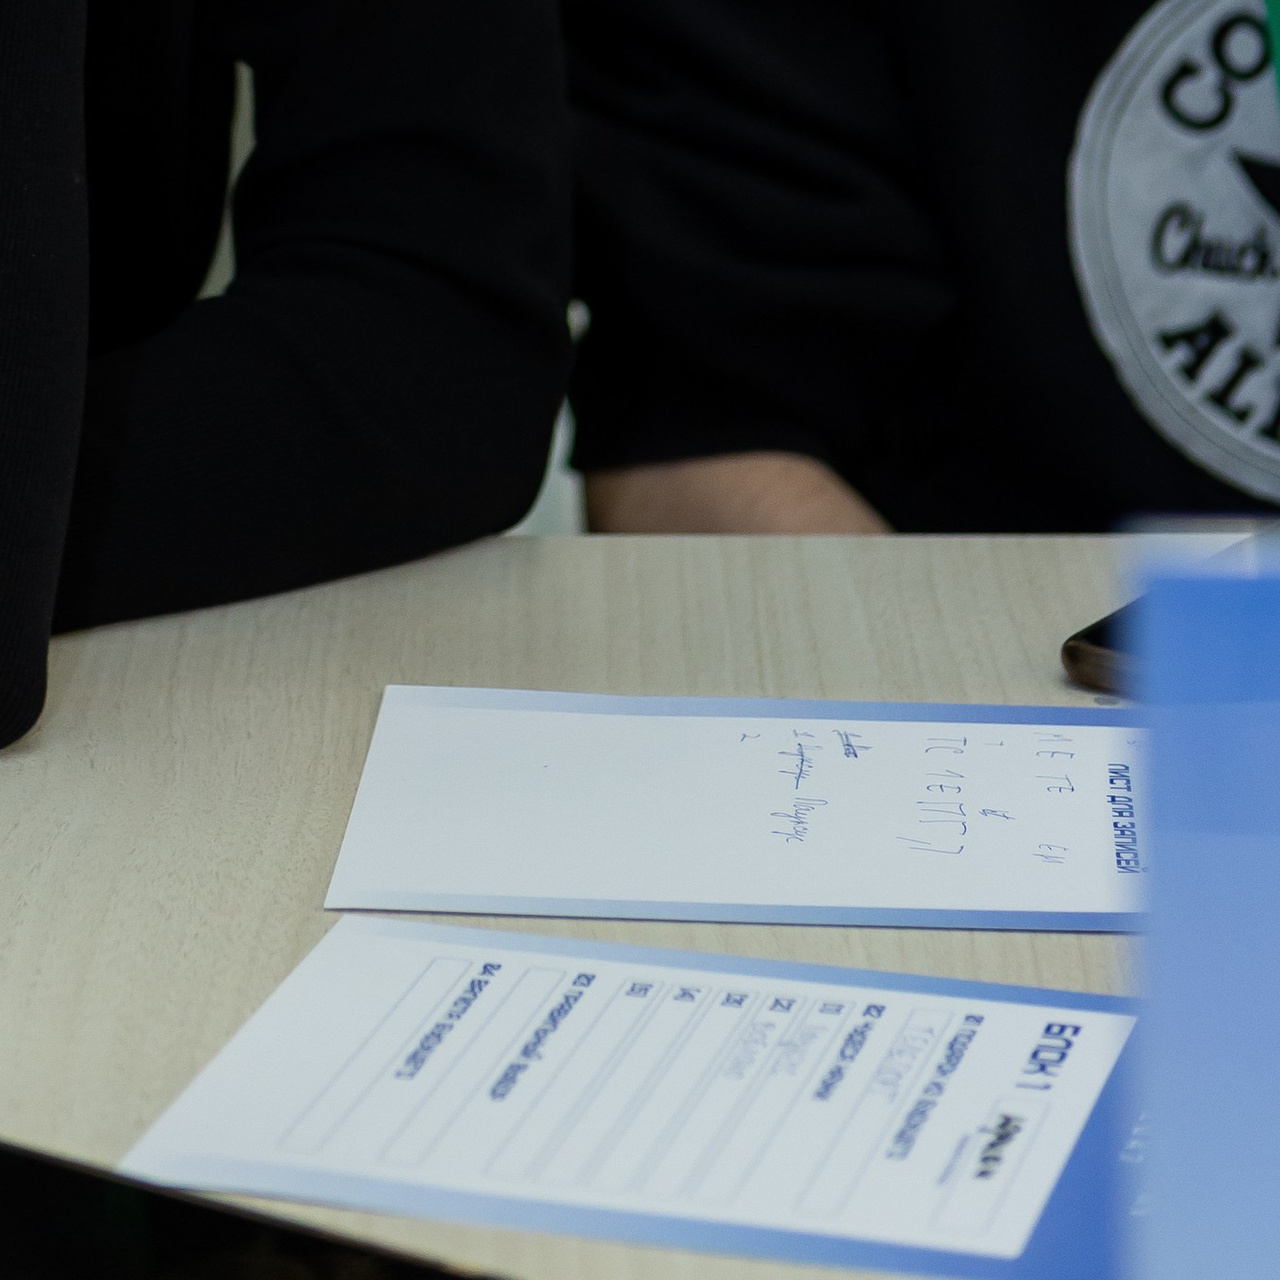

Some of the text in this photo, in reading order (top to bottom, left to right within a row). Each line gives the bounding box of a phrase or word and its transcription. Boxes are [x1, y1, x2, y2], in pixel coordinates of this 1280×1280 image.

[1107, 762, 1148, 875] ЛИСТ ДЛЯ ЗАПИСЕЙ
[1021, 1022, 1083, 1077] БЛОК
